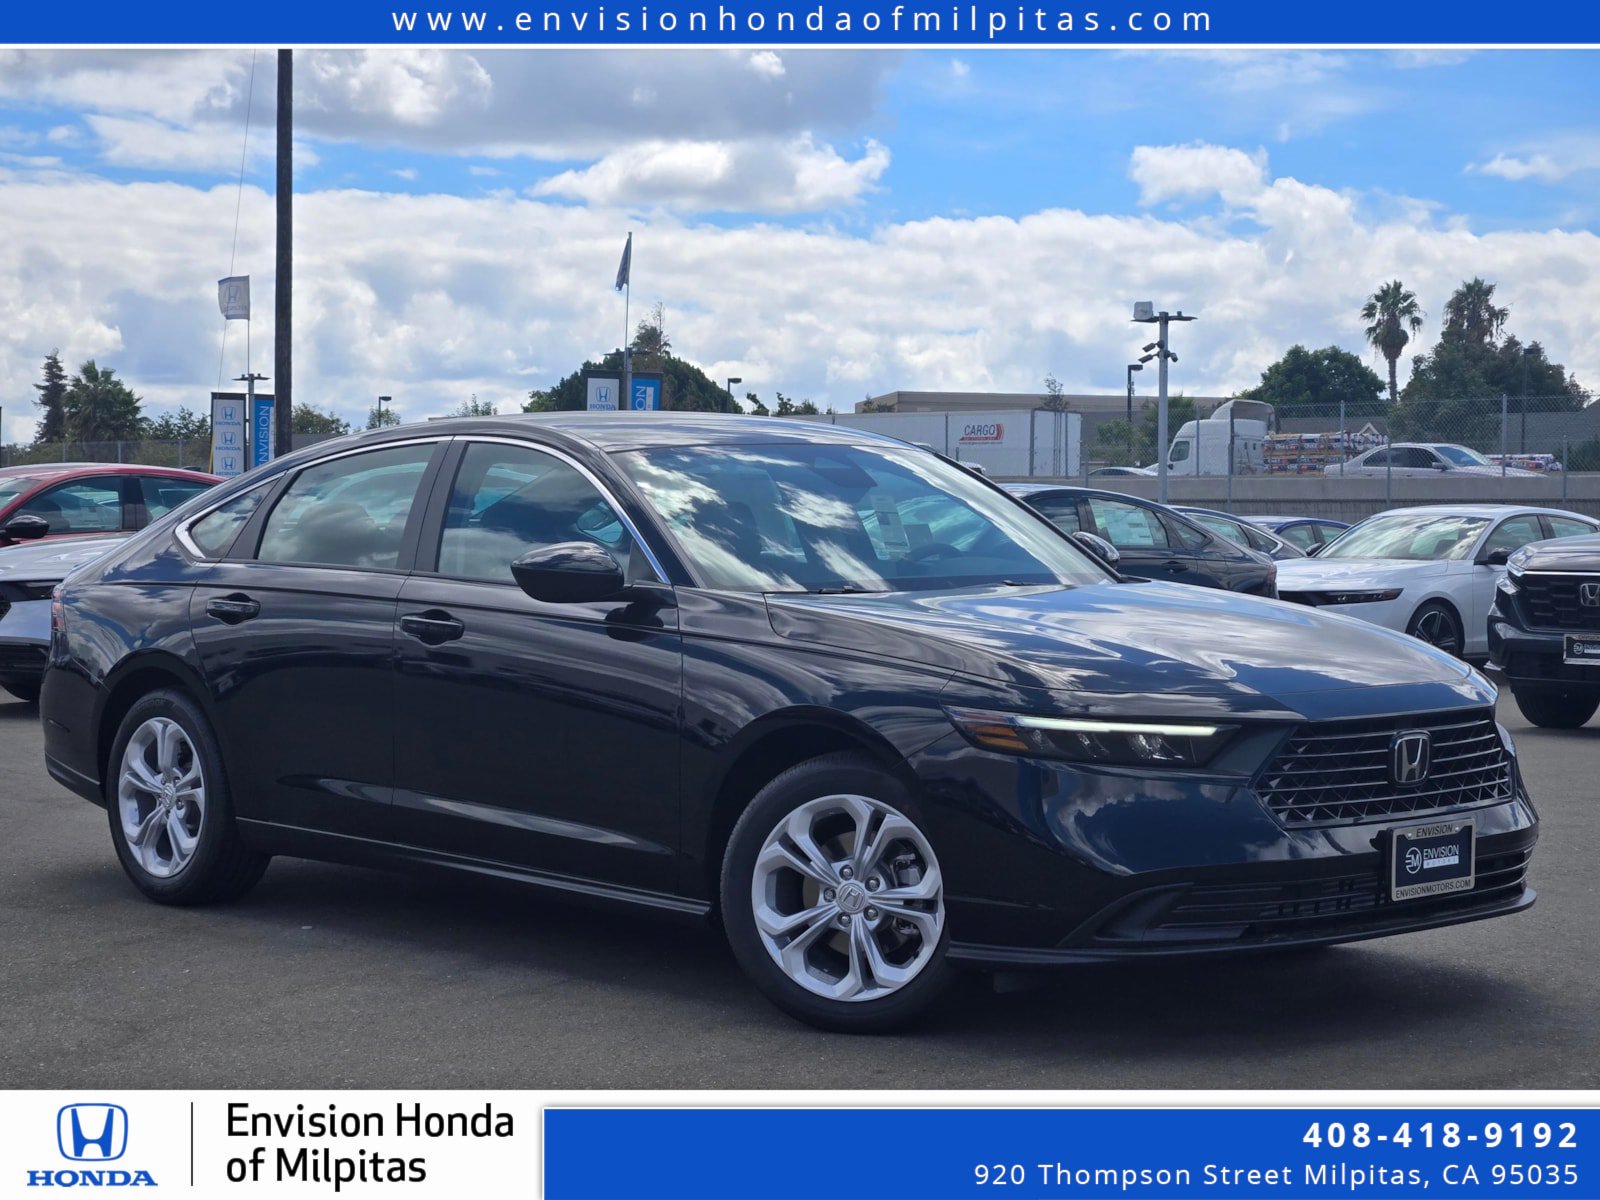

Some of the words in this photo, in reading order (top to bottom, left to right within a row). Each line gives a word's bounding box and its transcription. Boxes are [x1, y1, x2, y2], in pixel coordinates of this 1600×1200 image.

[964, 424, 996, 436] CARGO
[1416, 823, 1454, 838] ENVISION
[1423, 844, 1460, 860] ENVISION
[1395, 878, 1472, 899] ENVISIONMOTORS.COM
